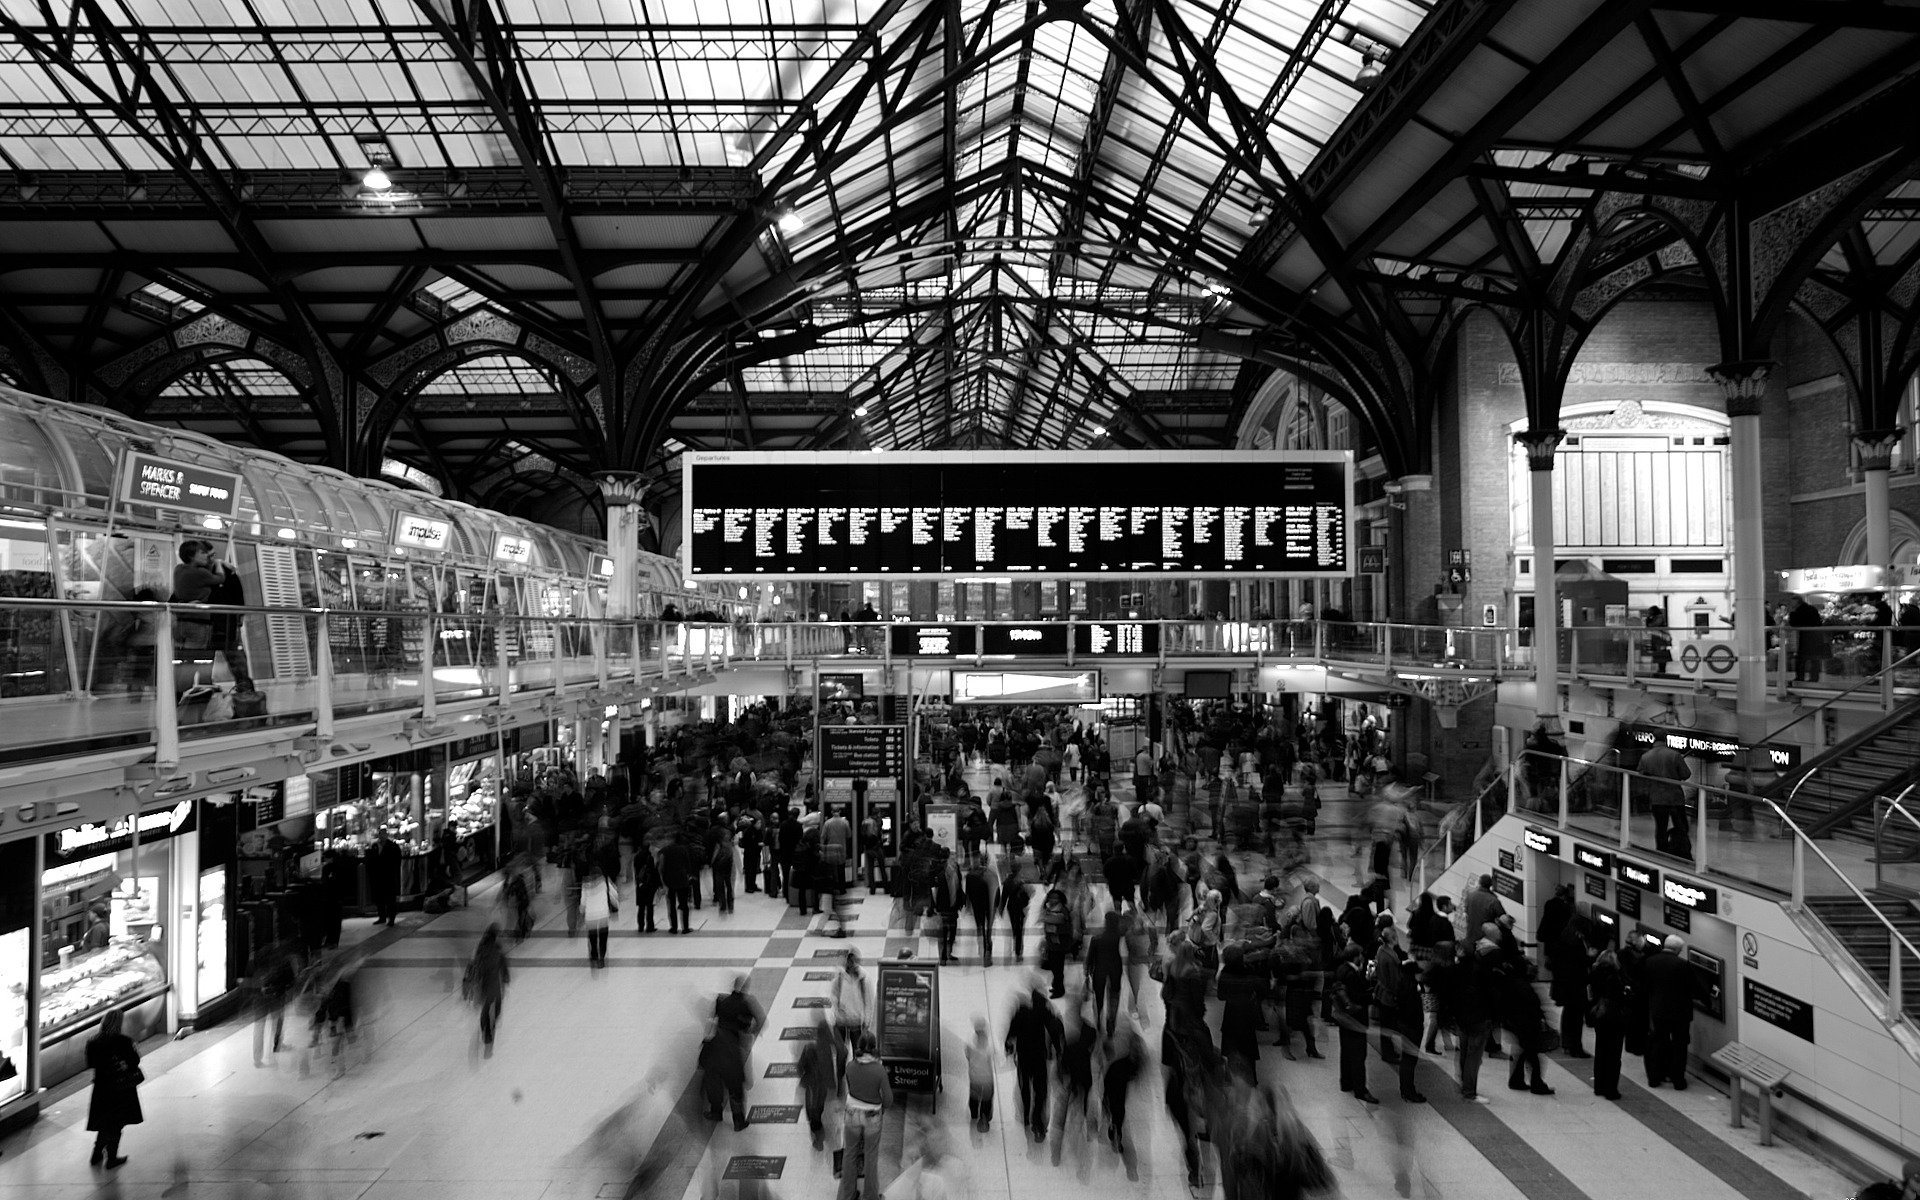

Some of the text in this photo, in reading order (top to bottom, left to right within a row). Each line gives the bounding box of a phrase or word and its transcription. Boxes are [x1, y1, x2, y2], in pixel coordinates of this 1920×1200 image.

[141, 464, 176, 483] MARKS
[140, 480, 182, 500] SPENCER
[408, 522, 442, 541] impulse
[894, 1065, 929, 1076] Liverpool
